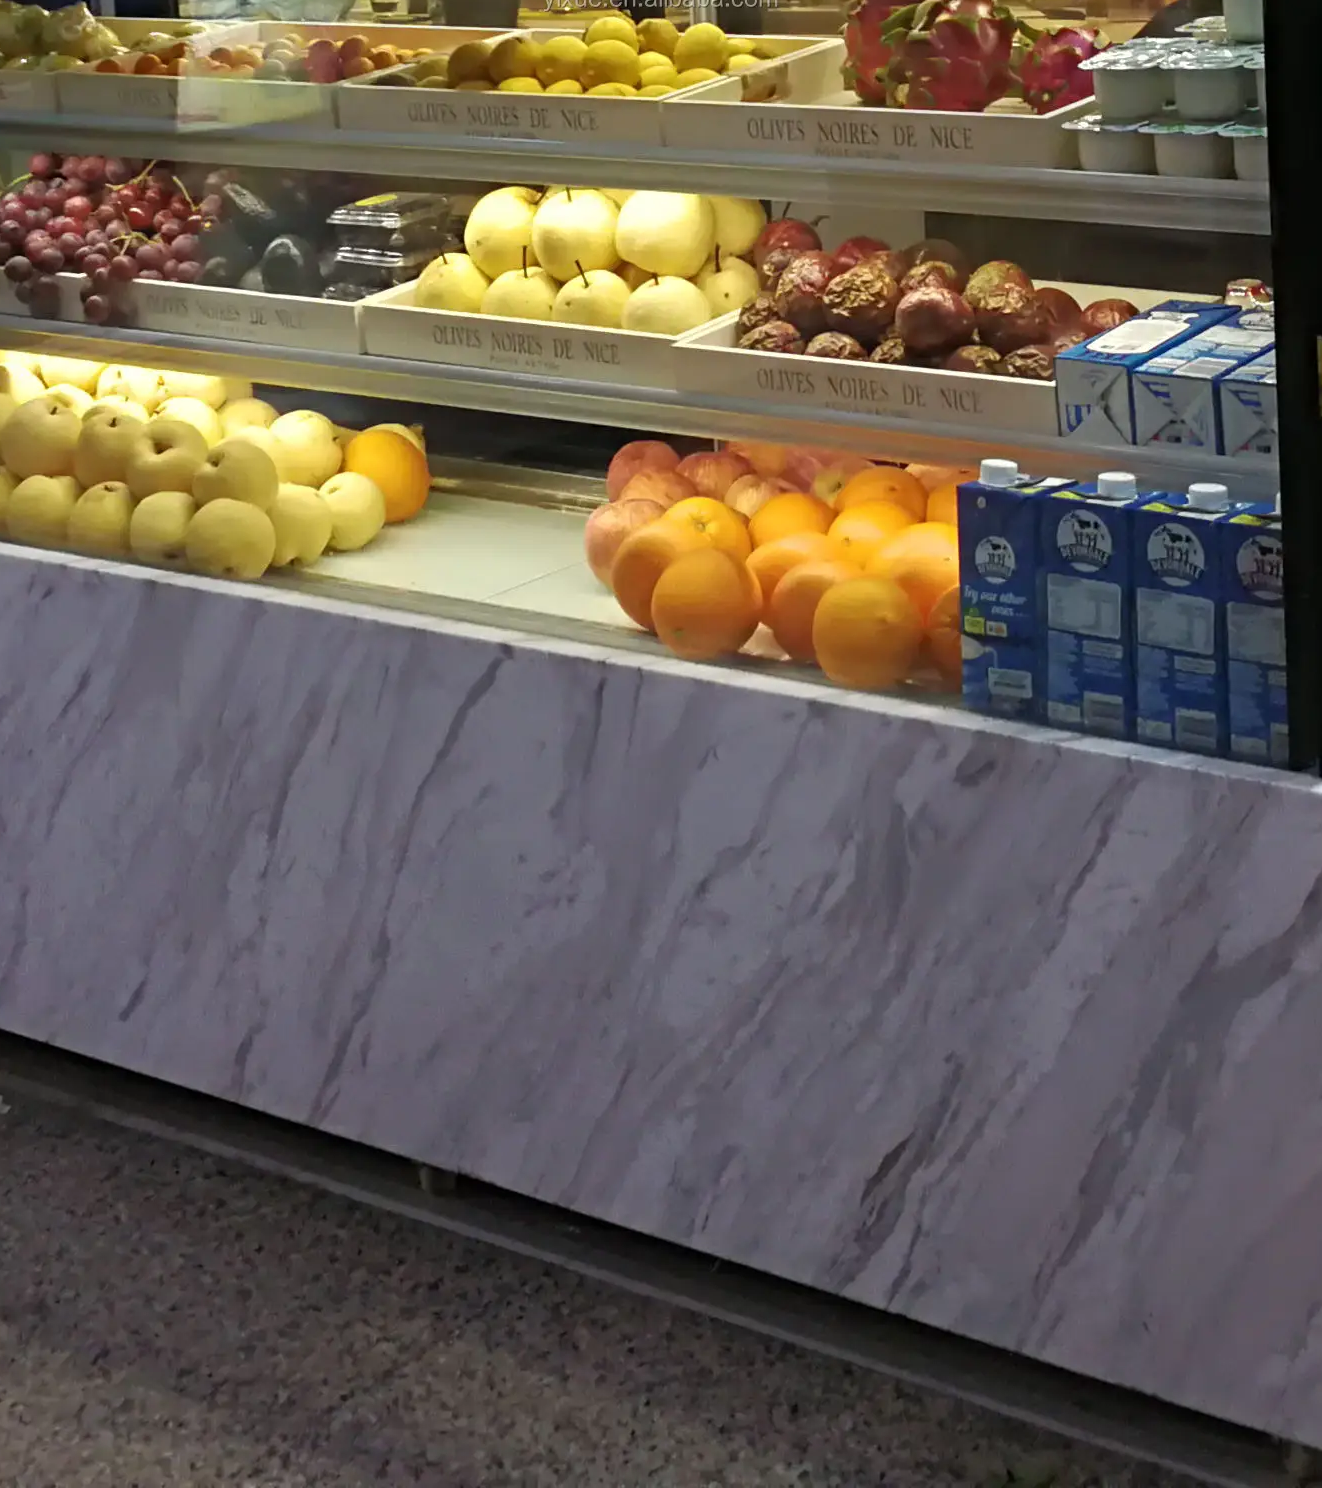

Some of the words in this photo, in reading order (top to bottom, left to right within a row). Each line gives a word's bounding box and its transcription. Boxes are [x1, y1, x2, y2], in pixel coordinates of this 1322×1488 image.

[466, 104, 518, 126] NOIRES
[530, 108, 550, 128] DE
[560, 109, 599, 131] NICE
[747, 118, 805, 142] OLIVES
[817, 120, 879, 145] NOIRES
[893, 124, 917, 147] DE
[929, 124, 974, 150] NICE
[433, 325, 481, 348] OLIVES
[491, 331, 543, 356] NOIRES
[553, 338, 574, 360] DE
[583, 341, 620, 365] NICE
[757, 368, 815, 395] OLIVES
[827, 375, 889, 401] NOIRES
[902, 382, 926, 407] DE
[940, 387, 984, 413] NICE
